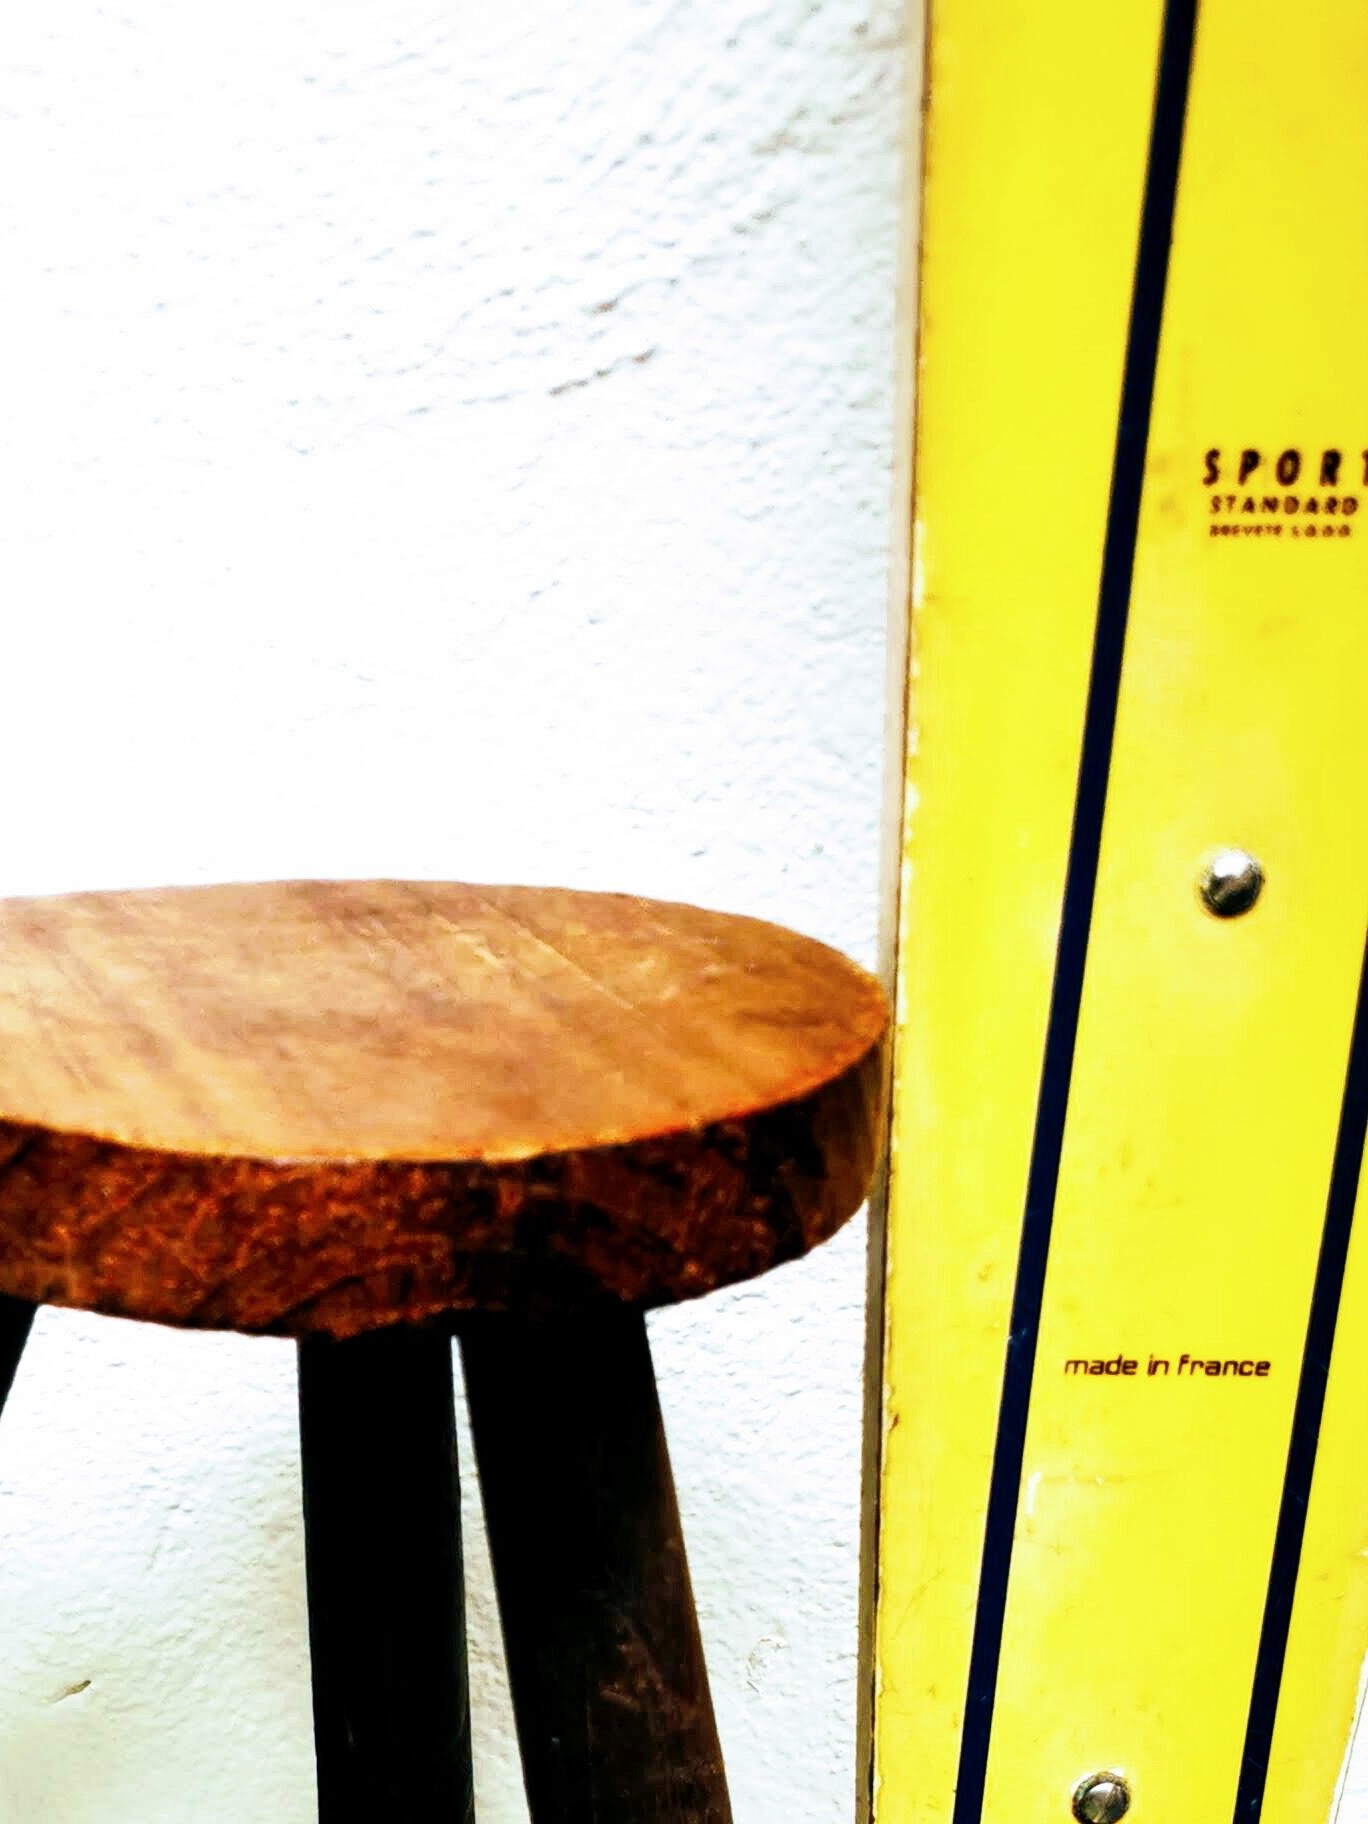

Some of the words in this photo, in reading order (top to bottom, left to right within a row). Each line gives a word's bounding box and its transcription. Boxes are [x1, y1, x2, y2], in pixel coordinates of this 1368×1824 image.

[1210, 495, 1358, 514] STANDARD
[1064, 1354, 1139, 1375] made
[1147, 1354, 1170, 1376] in
[1177, 1354, 1271, 1376] france
